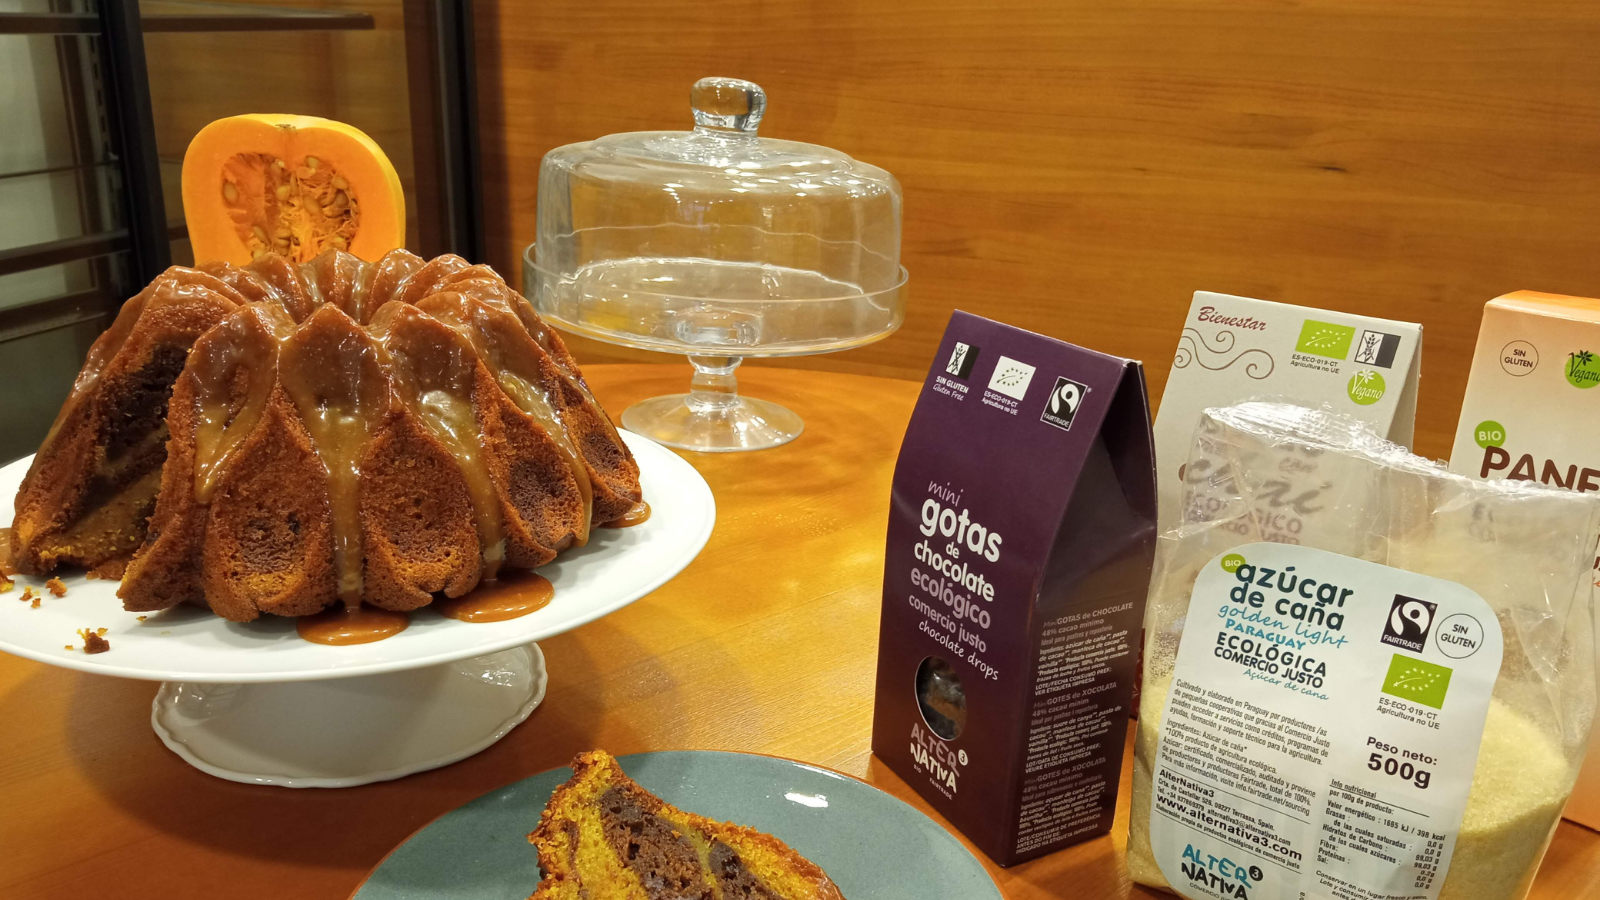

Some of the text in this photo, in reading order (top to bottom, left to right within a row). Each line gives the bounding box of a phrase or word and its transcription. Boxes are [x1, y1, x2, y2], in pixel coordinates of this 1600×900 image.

[1197, 306, 1266, 331] Bienestar
[1290, 360, 1321, 372] Agricultura
[1292, 354, 1338, 367] ES-ECO-019-CT
[1504, 356, 1533, 368] GLUTEN
[1513, 349, 1526, 357] SIN
[933, 384, 964, 401] Gluten Free
[936, 376, 969, 394] SIN GLUTEN
[984, 391, 1018, 408] ES-ECO-019-CT
[1351, 370, 1382, 400] Vegano
[982, 398, 1003, 410] Agricultura
[1011, 407, 1018, 415] UE
[1044, 413, 1069, 427] FAIRTRADE
[1479, 430, 1502, 441] BIO
[928, 481, 964, 507] mini
[920, 498, 1002, 562] gotas
[946, 542, 960, 559] de
[914, 540, 995, 602] chocolate
[1236, 564, 1354, 608] azúcar
[910, 567, 991, 629] ecológico
[1092, 602, 1134, 618] CHOCOLATE
[1230, 582, 1345, 631] de caña
[909, 594, 986, 653] comercio justo
[1218, 605, 1349, 649] golden light
[1225, 618, 1306, 650] PARAGUAY
[1452, 624, 1469, 635] SIN
[918, 620, 964, 658] chocolate
[967, 652, 999, 681] drops
[1216, 631, 1326, 677] ECOLÓGICA
[1383, 634, 1422, 651] FAIRTRADE
[1440, 633, 1476, 649] GLUTEN
[1214, 647, 1323, 689] COMERCIO JUSTO
[1082, 682, 1117, 696] XOCOLATA
[1243, 668, 1329, 701] Açúcar de cana
[1173, 688, 1330, 748] de pequeñas cooperativas que gracias Comercio Justo
[1176, 678, 1201, 693] Cultivado
[1207, 690, 1234, 704] elaborado
[1243, 701, 1269, 717] Paraguay
[1269, 712, 1280, 720] por
[1280, 715, 1316, 732] productores
[1377, 705, 1415, 722] Agricultura
[1428, 722, 1440, 730] UE
[1166, 717, 1201, 736] Ingredientes:
[1201, 730, 1221, 743] Azúcar
[1221, 738, 1229, 747] de
[1169, 706, 1322, 765] ayudas, formación soporte técnico para agricultura.
[1171, 697, 1191, 709] pueden
[1191, 705, 1214, 717] acceder
[1219, 714, 1243, 728] servicios
[1244, 723, 1260, 733] como
[1286, 738, 1319, 754] programas
[1320, 748, 1328, 757] de
[911, 722, 960, 778] ALTER
[1184, 735, 1209, 748] producto
[1209, 743, 1217, 751] de
[1217, 747, 1247, 763] agricultura
[1248, 759, 1277, 774] ecológica.
[1366, 736, 1437, 766] Peso neto:
[910, 742, 957, 794] NATIVA
[1159, 769, 1214, 797] AlterNativa3
[1161, 751, 1172, 762] Para
[1173, 759, 1184, 768] más
[1220, 777, 1234, 787] visite
[1168, 748, 1201, 764] productores
[1206, 762, 1239, 779] productoras
[1240, 773, 1267, 790] Fairtrade,
[1269, 784, 1282, 795] total
[1284, 790, 1292, 799] de
[1367, 752, 1431, 789] 500g
[1258, 772, 1284, 785] auditado
[1290, 783, 1316, 797] proviene
[1331, 778, 1376, 798] Info nutricional
[1325, 807, 1345, 820] Grasas
[1327, 799, 1342, 809] Valor
[1344, 806, 1375, 821] energético
[1156, 793, 1302, 861] www.alternativa3.com
[1322, 823, 1346, 837] Hidratos
[1333, 819, 1406, 849] de las cuales saturadas
[1337, 837, 1346, 845] los
[1348, 842, 1368, 853] cuales
[1181, 862, 1248, 900] NATIVA
[1182, 844, 1252, 889] ALTER
[1316, 870, 1348, 887] Conservar
[1320, 878, 1333, 888] Lote
